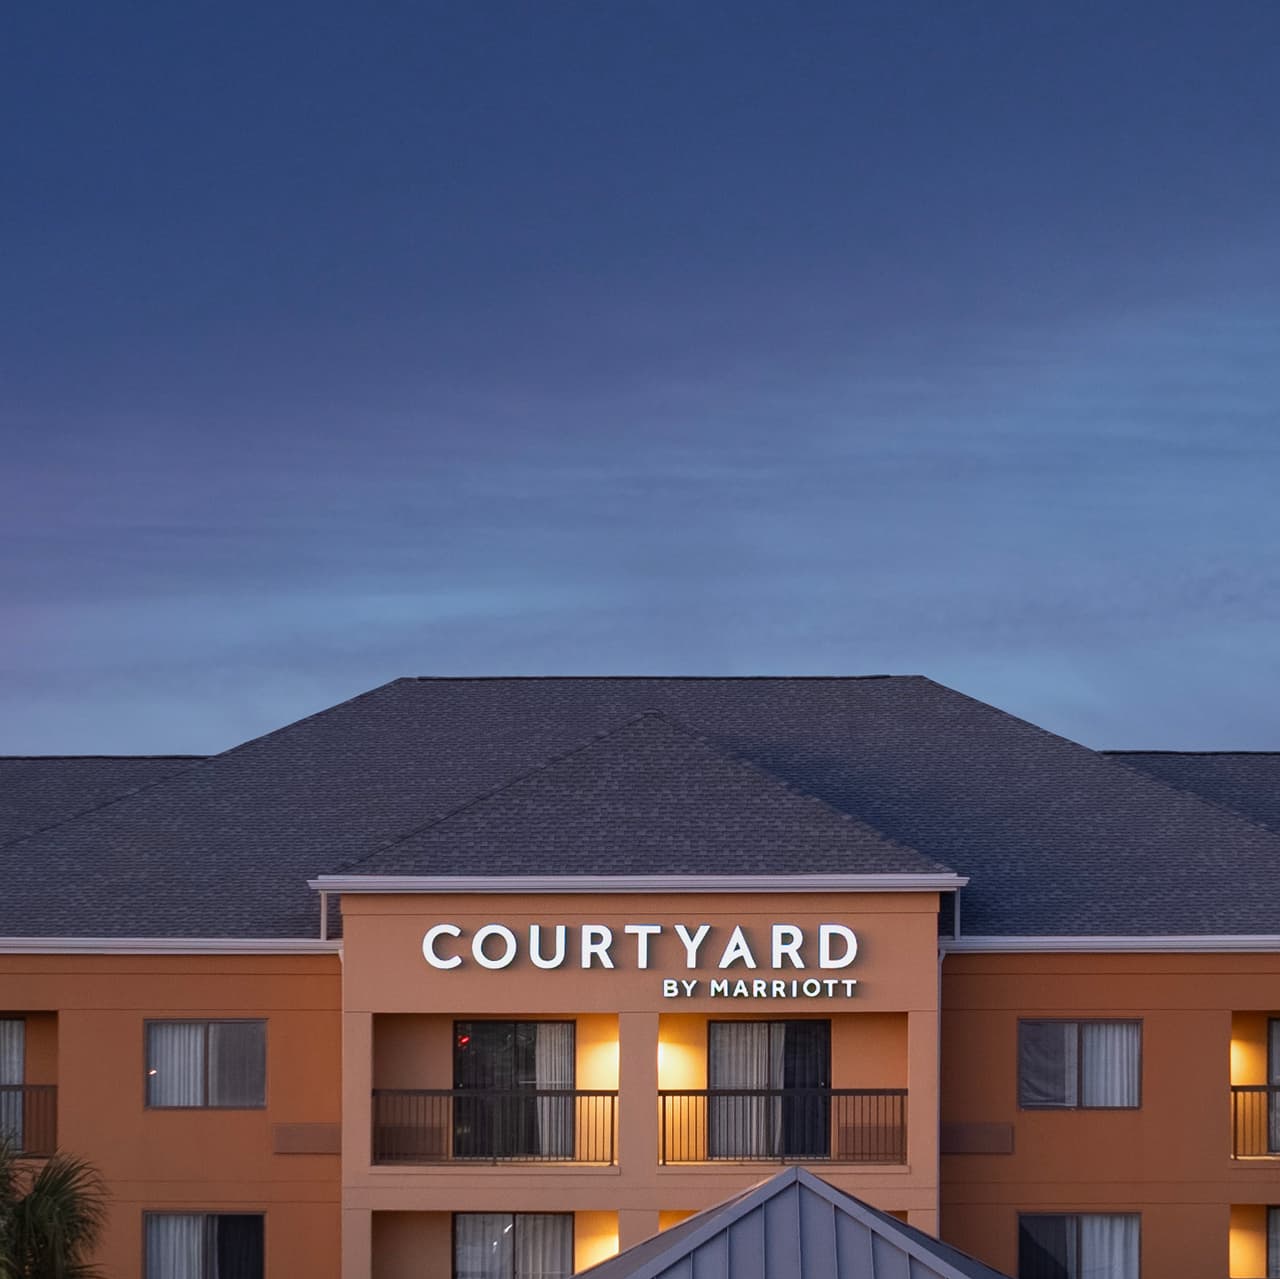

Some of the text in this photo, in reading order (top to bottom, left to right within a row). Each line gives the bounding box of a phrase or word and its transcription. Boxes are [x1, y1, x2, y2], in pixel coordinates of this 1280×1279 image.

[422, 924, 858, 970] COURTYARD
[663, 978, 857, 998] BY MARRIOTT
